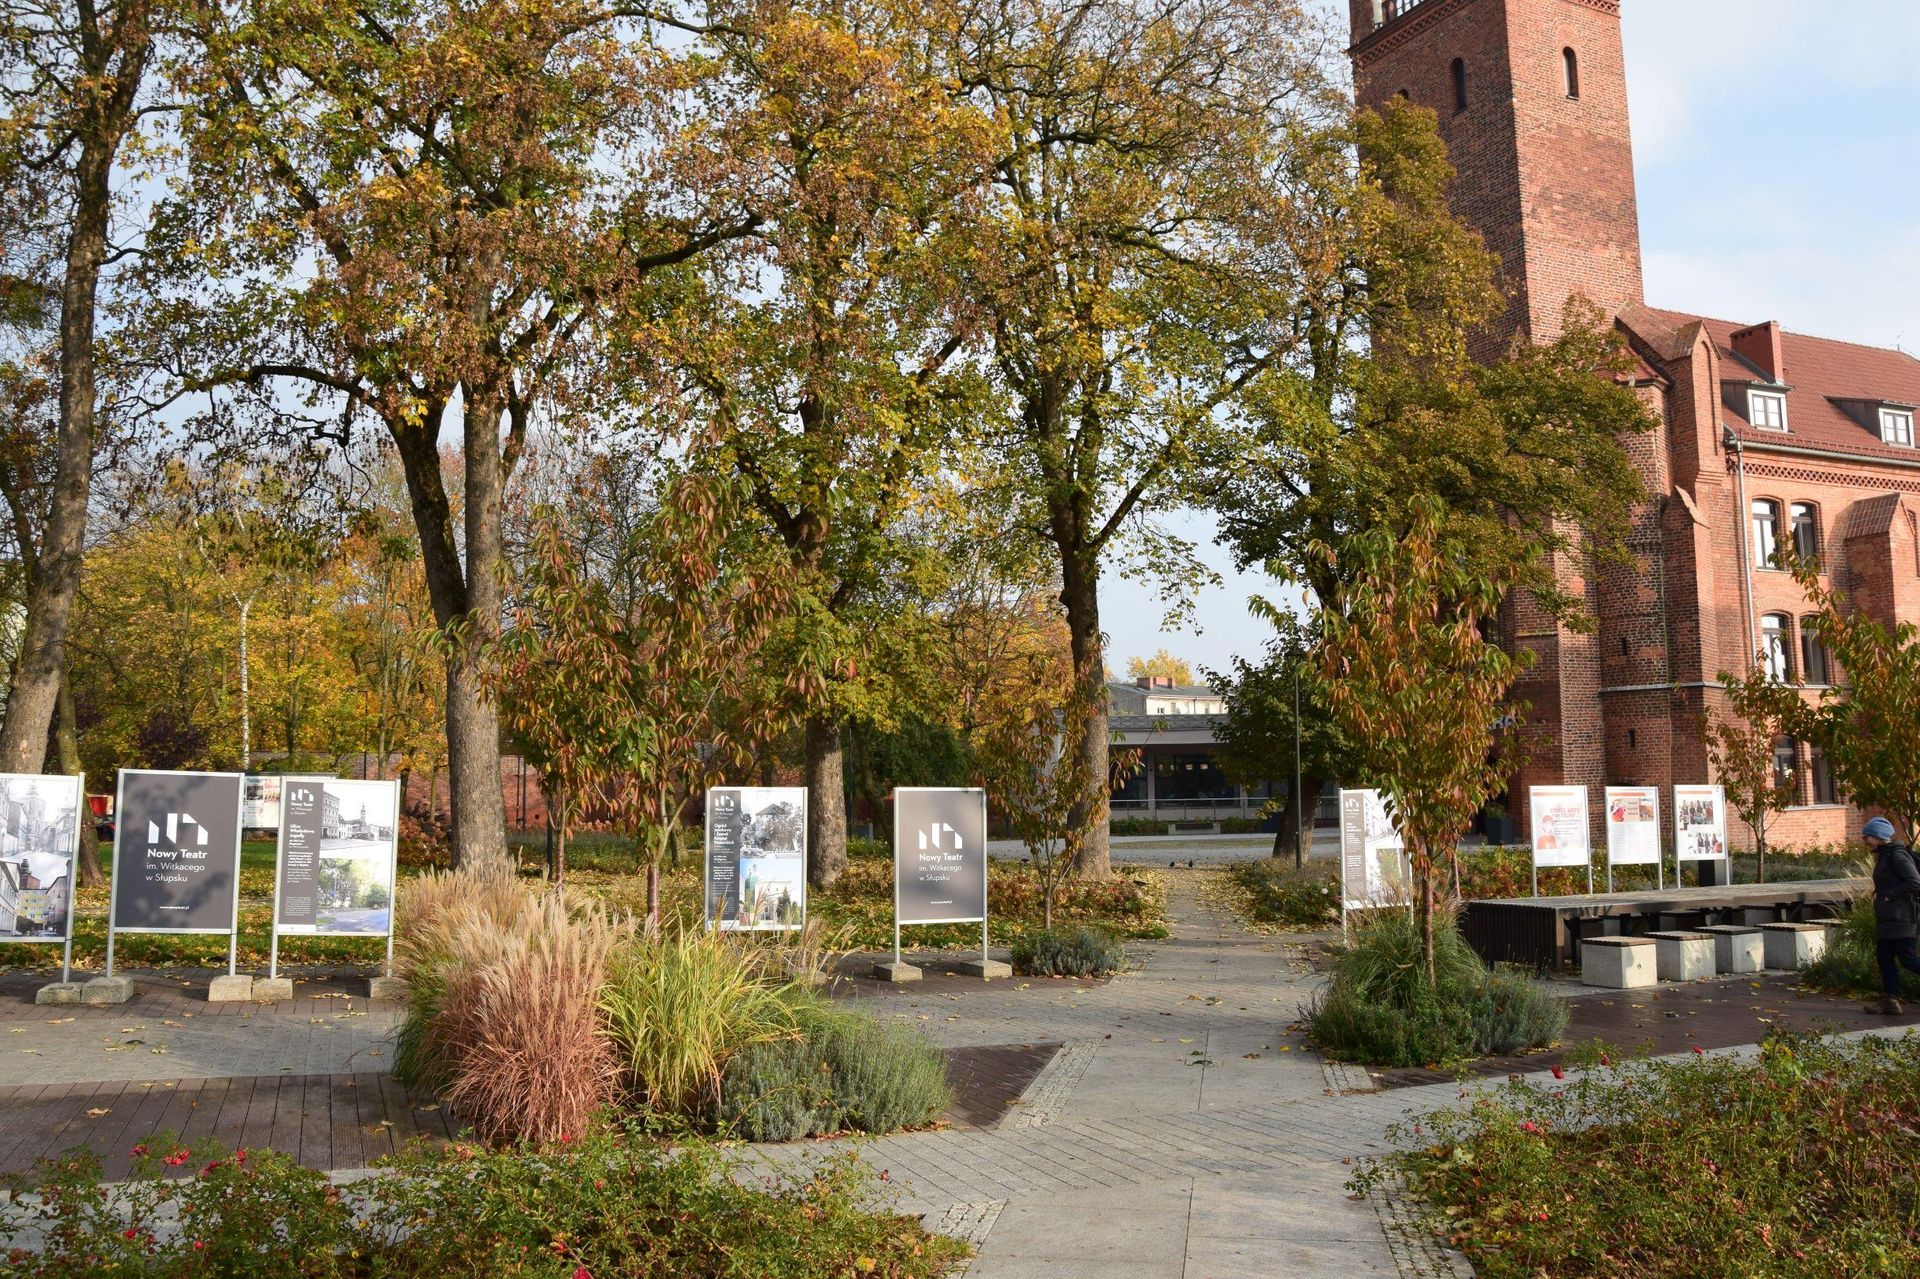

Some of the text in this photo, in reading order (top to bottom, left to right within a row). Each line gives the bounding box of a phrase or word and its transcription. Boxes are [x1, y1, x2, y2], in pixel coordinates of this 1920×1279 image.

[147, 848, 208, 861] Nowy Teatr
[919, 852, 963, 864] Nowy Teatr
[146, 862, 205, 873] im. Witkacego
[930, 864, 962, 873] Witkacego
[155, 873, 188, 884] Słupsku
[926, 873, 950, 882] Słupsku
